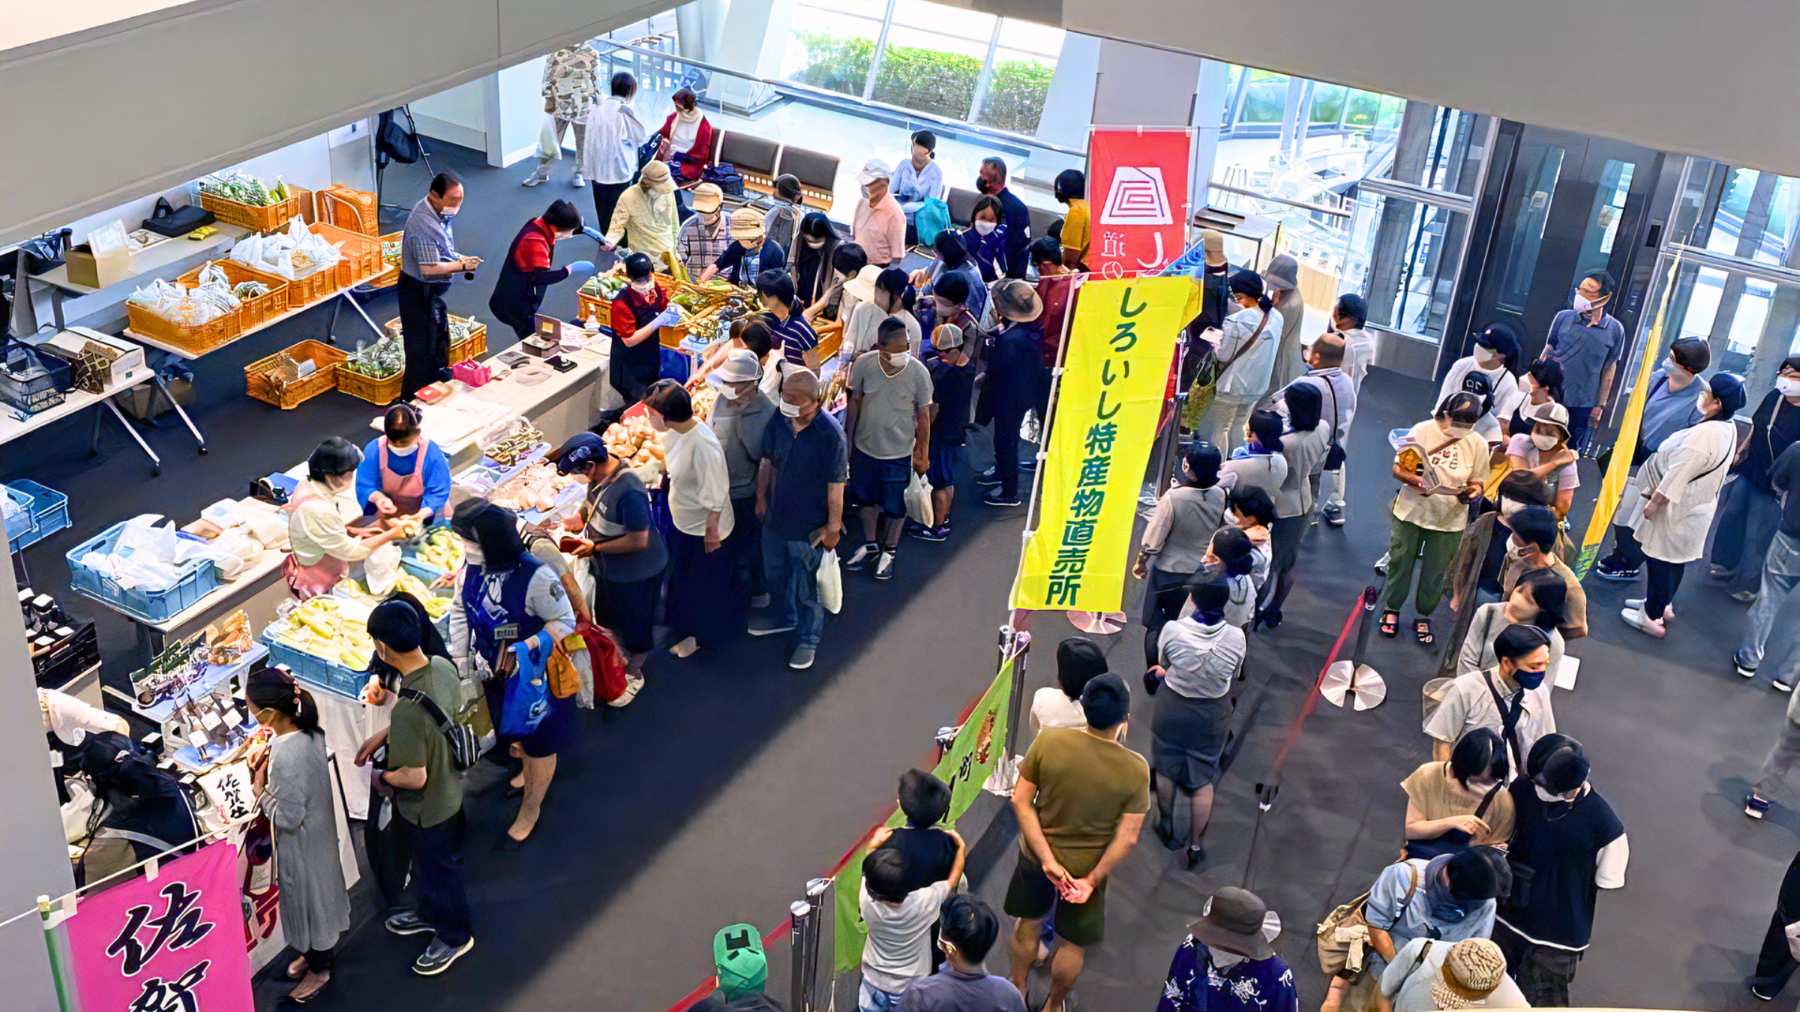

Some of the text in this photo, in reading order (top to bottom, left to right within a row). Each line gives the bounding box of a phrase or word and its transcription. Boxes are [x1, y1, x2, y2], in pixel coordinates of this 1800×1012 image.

[1045, 287, 1147, 606] しろいし特産物直売所
